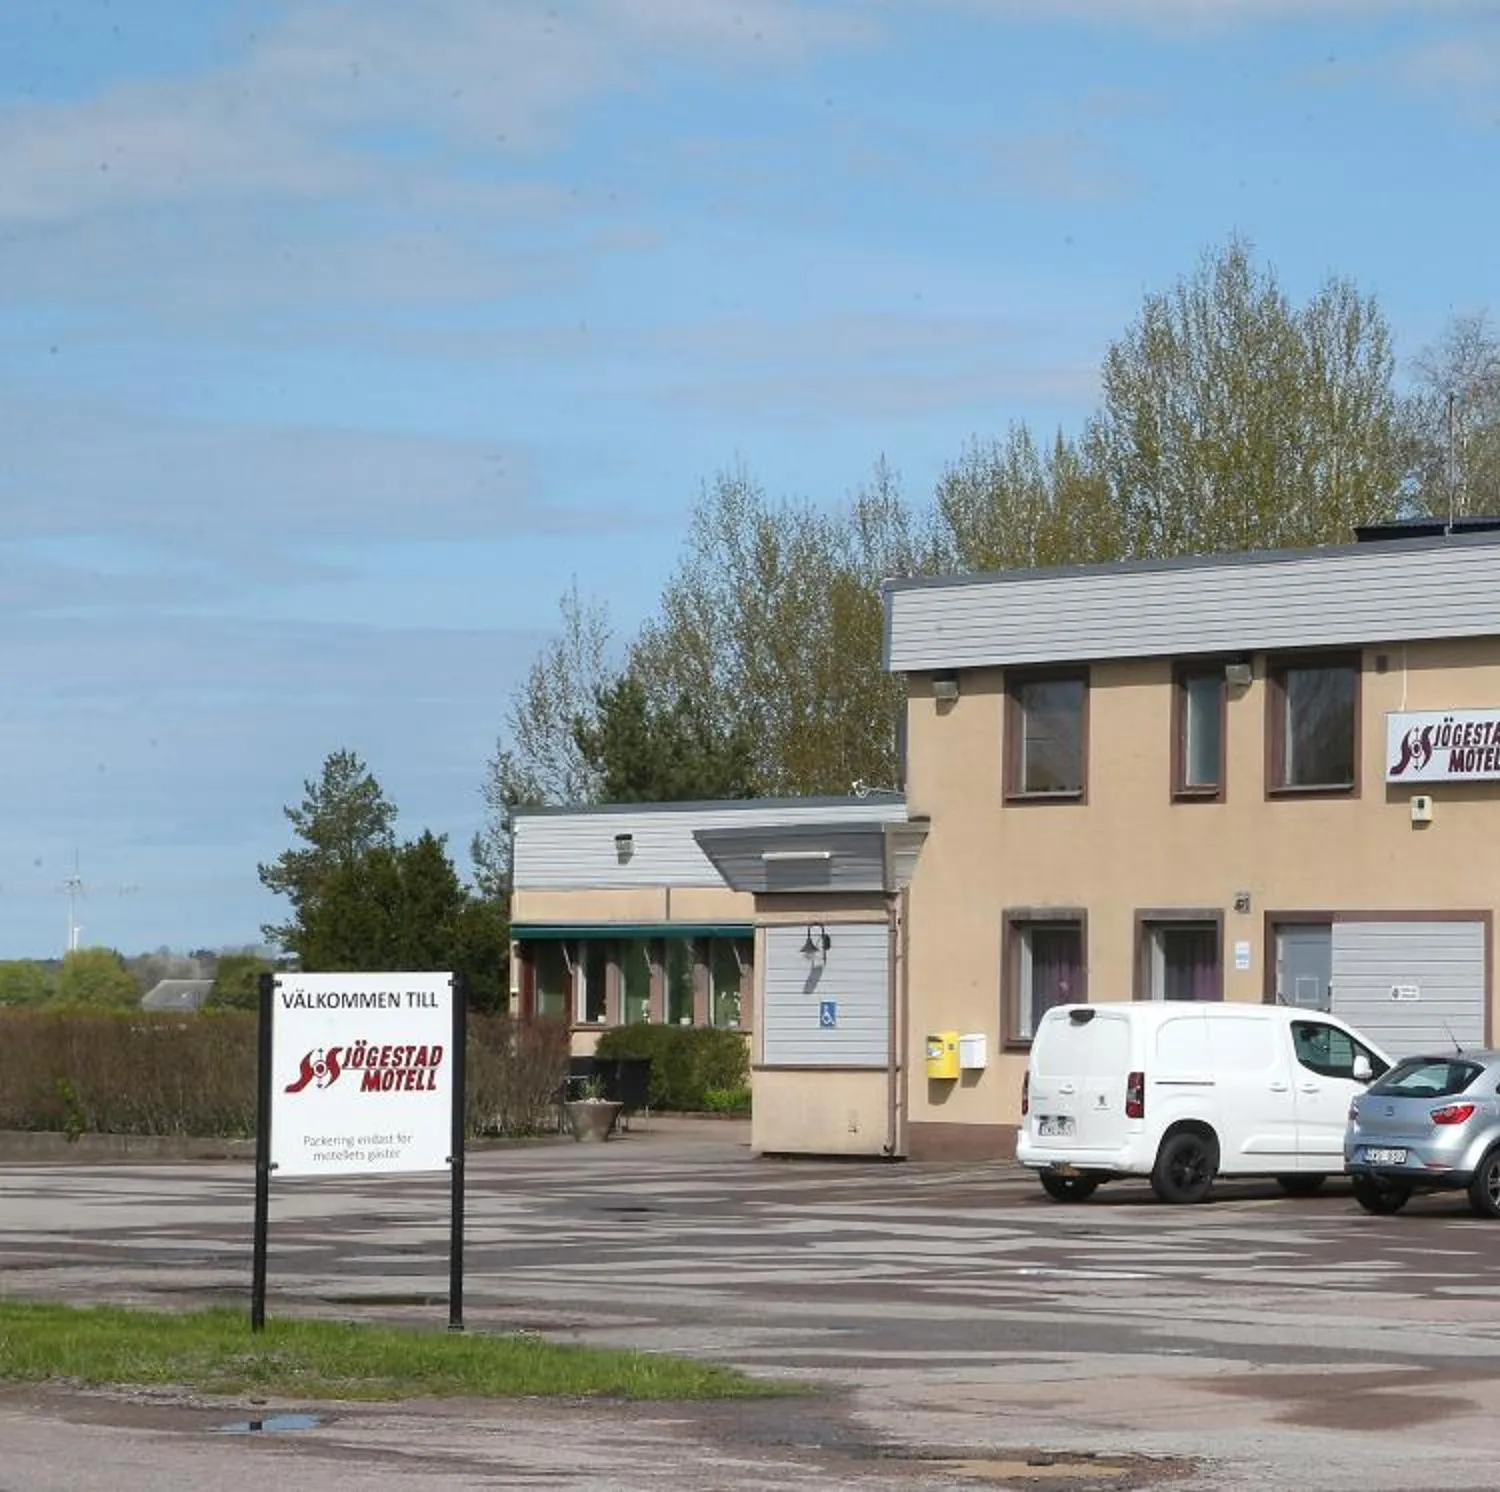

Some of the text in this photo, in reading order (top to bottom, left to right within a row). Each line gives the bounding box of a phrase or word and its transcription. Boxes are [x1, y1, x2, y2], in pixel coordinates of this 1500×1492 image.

[282, 989, 439, 1009] VÄLKOMMEN TILL
[360, 1069, 437, 1092] MOTELL
